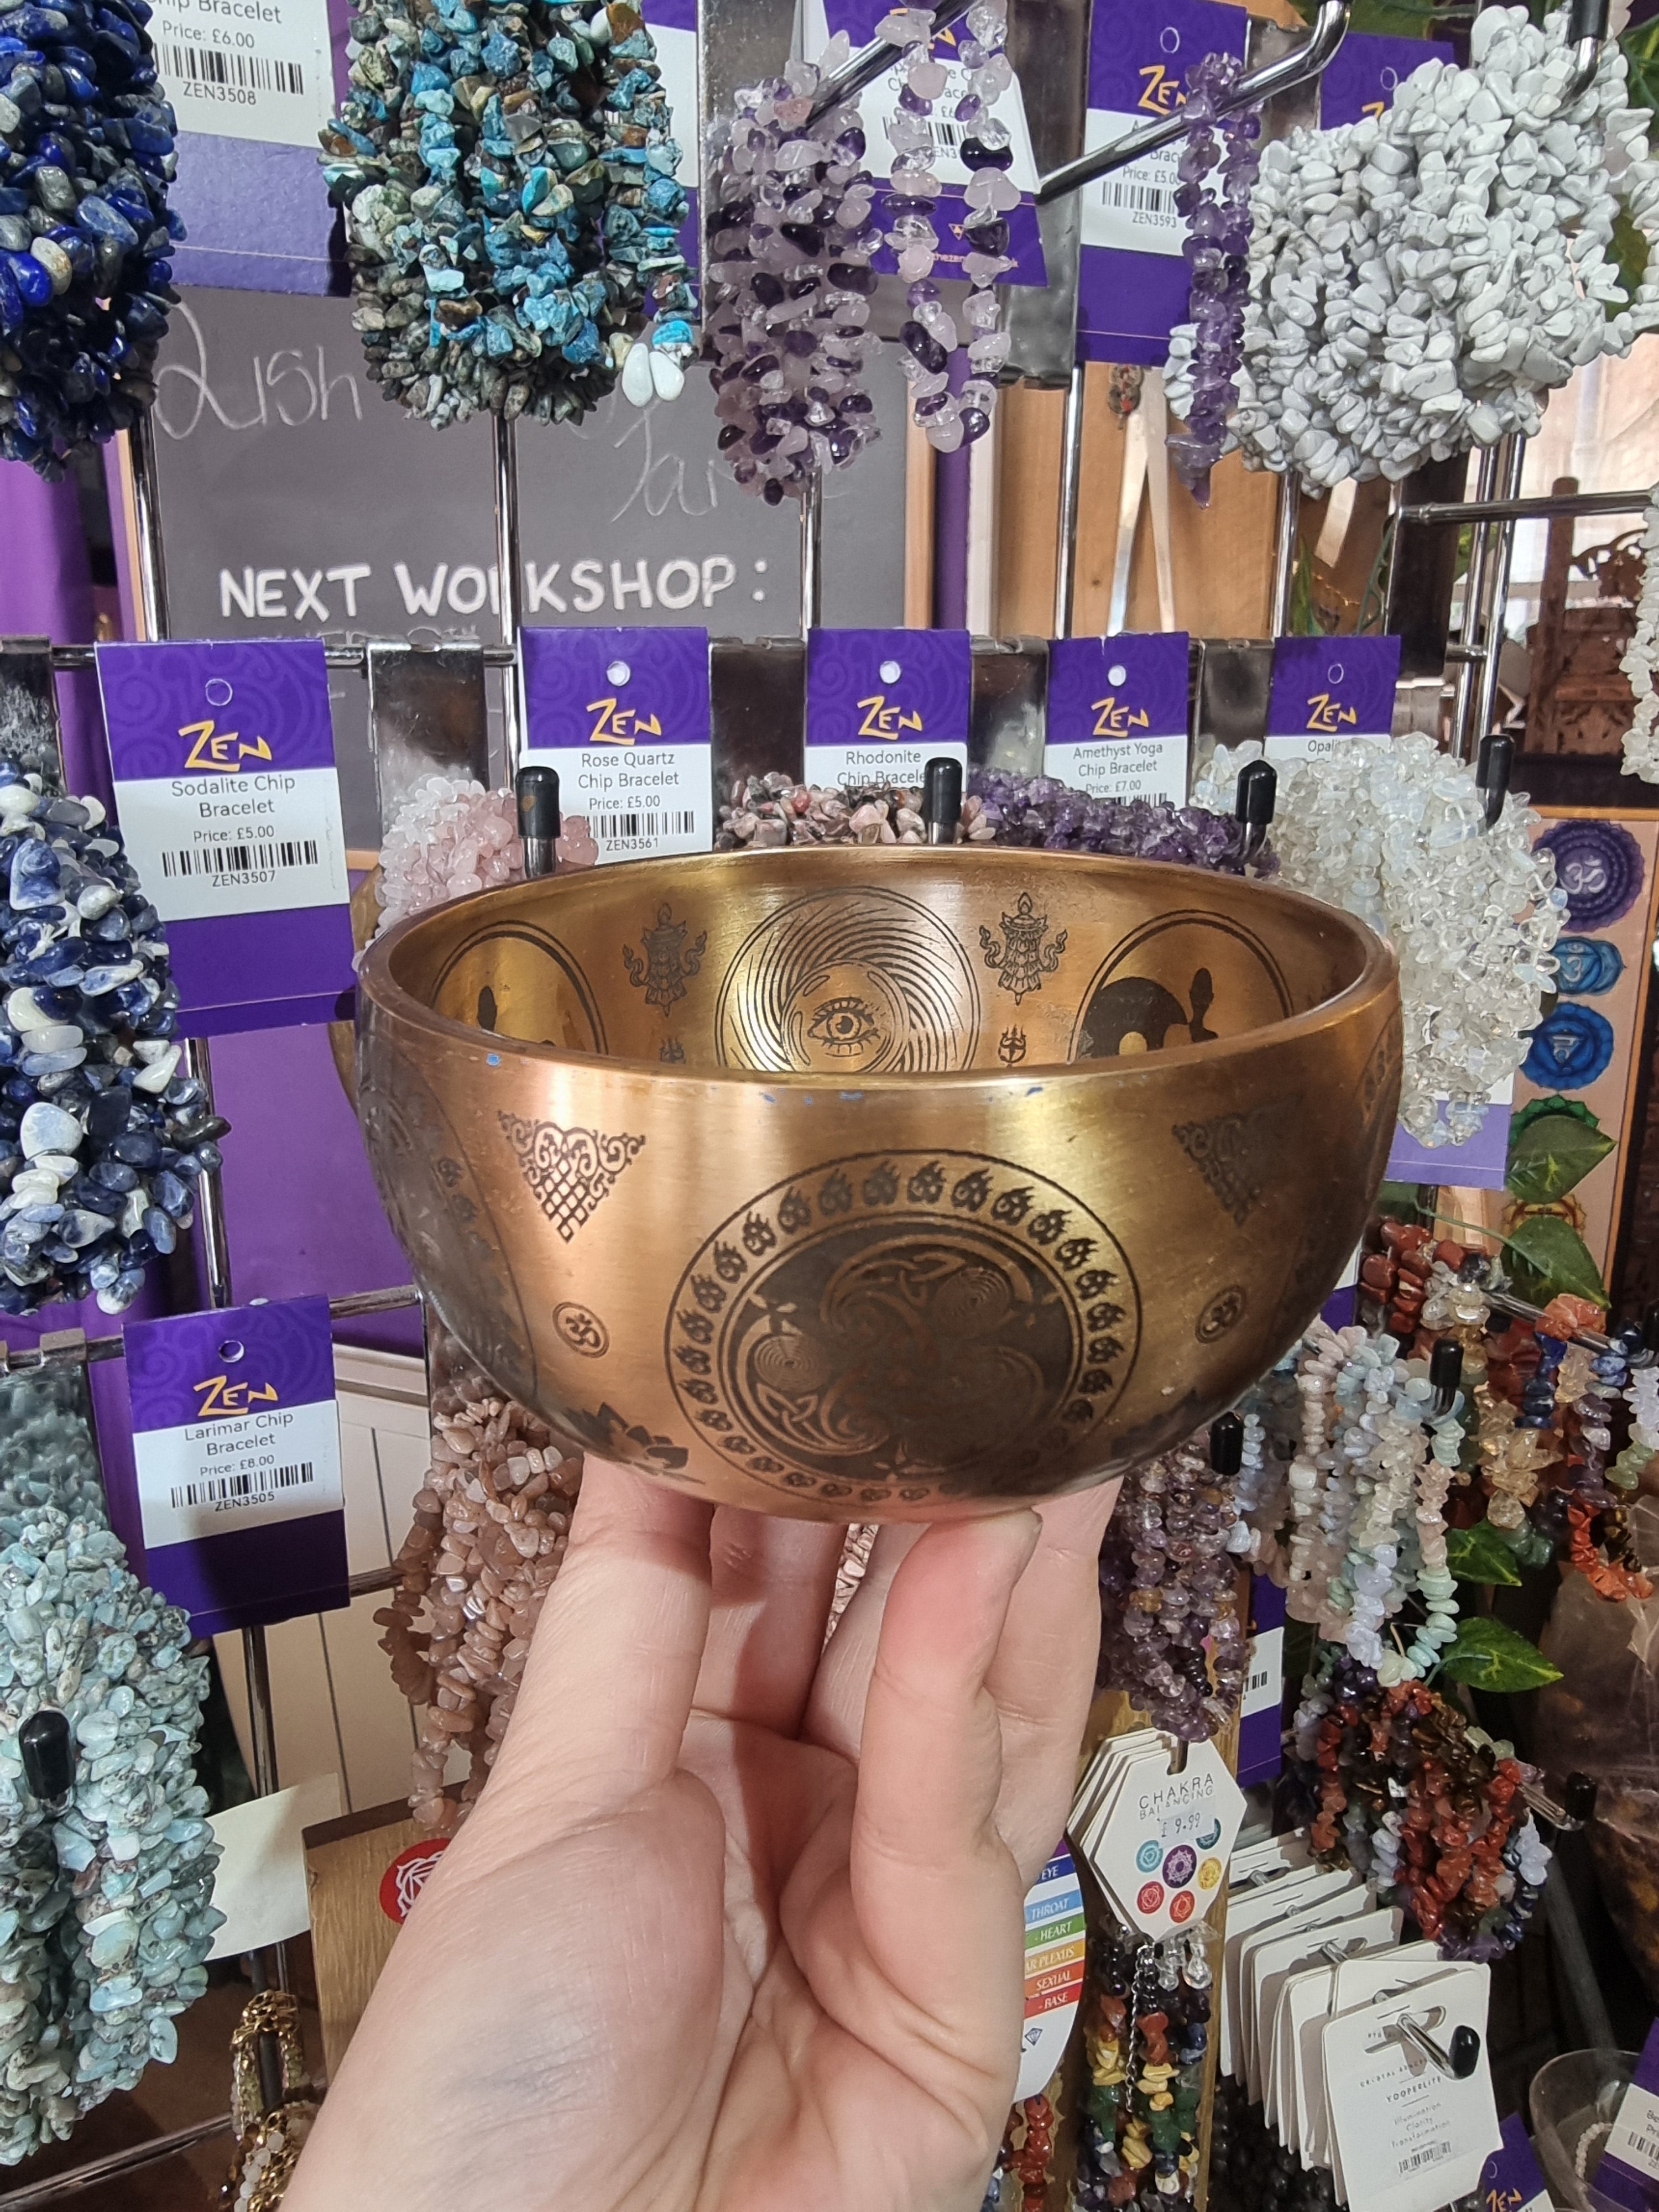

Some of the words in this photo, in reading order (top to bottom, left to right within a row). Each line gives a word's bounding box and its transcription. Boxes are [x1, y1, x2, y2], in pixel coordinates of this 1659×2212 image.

[163, 20, 206, 41] Price:
[212, 29, 255, 48] £6.00
[182, 81, 257, 105] ZEN3508
[1132, 211, 1177, 228] ZEN3593
[221, 563, 371, 623] NEXT
[586, 698, 661, 745] ZEN
[857, 695, 922, 740] ZEN
[1091, 697, 1149, 737] ZEN
[1306, 693, 1357, 732] ZEN
[178, 719, 272, 772] ZEN
[1073, 743, 1131, 760] Amethyst
[1134, 742, 1163, 757] Yoga
[581, 753, 619, 768] Rose
[624, 752, 675, 768] Quartz
[846, 750, 921, 765] Rhodonite
[837, 771, 870, 786] Chip
[876, 769, 925, 784] Bracele
[1078, 763, 1105, 779] Chip
[1110, 760, 1158, 775] Bracelet
[171, 776, 249, 797] Sodalite
[254, 774, 295, 794] Chip
[578, 773, 613, 792] Chip
[619, 771, 679, 787] Bracelet
[1086, 783, 1112, 794] Price:
[1115, 780, 1141, 792] £7.00
[199, 799, 275, 818] Bracelet
[589, 797, 623, 810] Price:
[627, 795, 661, 808] £5.00
[194, 830, 232, 843] Price:
[237, 825, 274, 840] £5.00
[606, 837, 659, 851] ZEN3561
[212, 871, 275, 888] ZEN3507
[193, 1375, 278, 1417] ZEN
[185, 1419, 251, 1442] Larimar
[255, 1411, 294, 1428] Chip
[207, 1432, 276, 1456] Bracelet
[200, 1463, 236, 1477] Price:
[239, 1454, 275, 1470] £8.00
[215, 1491, 275, 1512] ZEN3505
[1139, 1773, 1214, 1809] CHAKRA
[1041, 1865, 1059, 1880] EYE
[1031, 1898, 1070, 1920] THROAT
[1040, 1921, 1072, 1941] HEART
[1039, 1946, 1074, 1969] PLEXUS
[1036, 1970, 1071, 1991] SEXUAL
[1045, 1992, 1068, 2010] BASE
